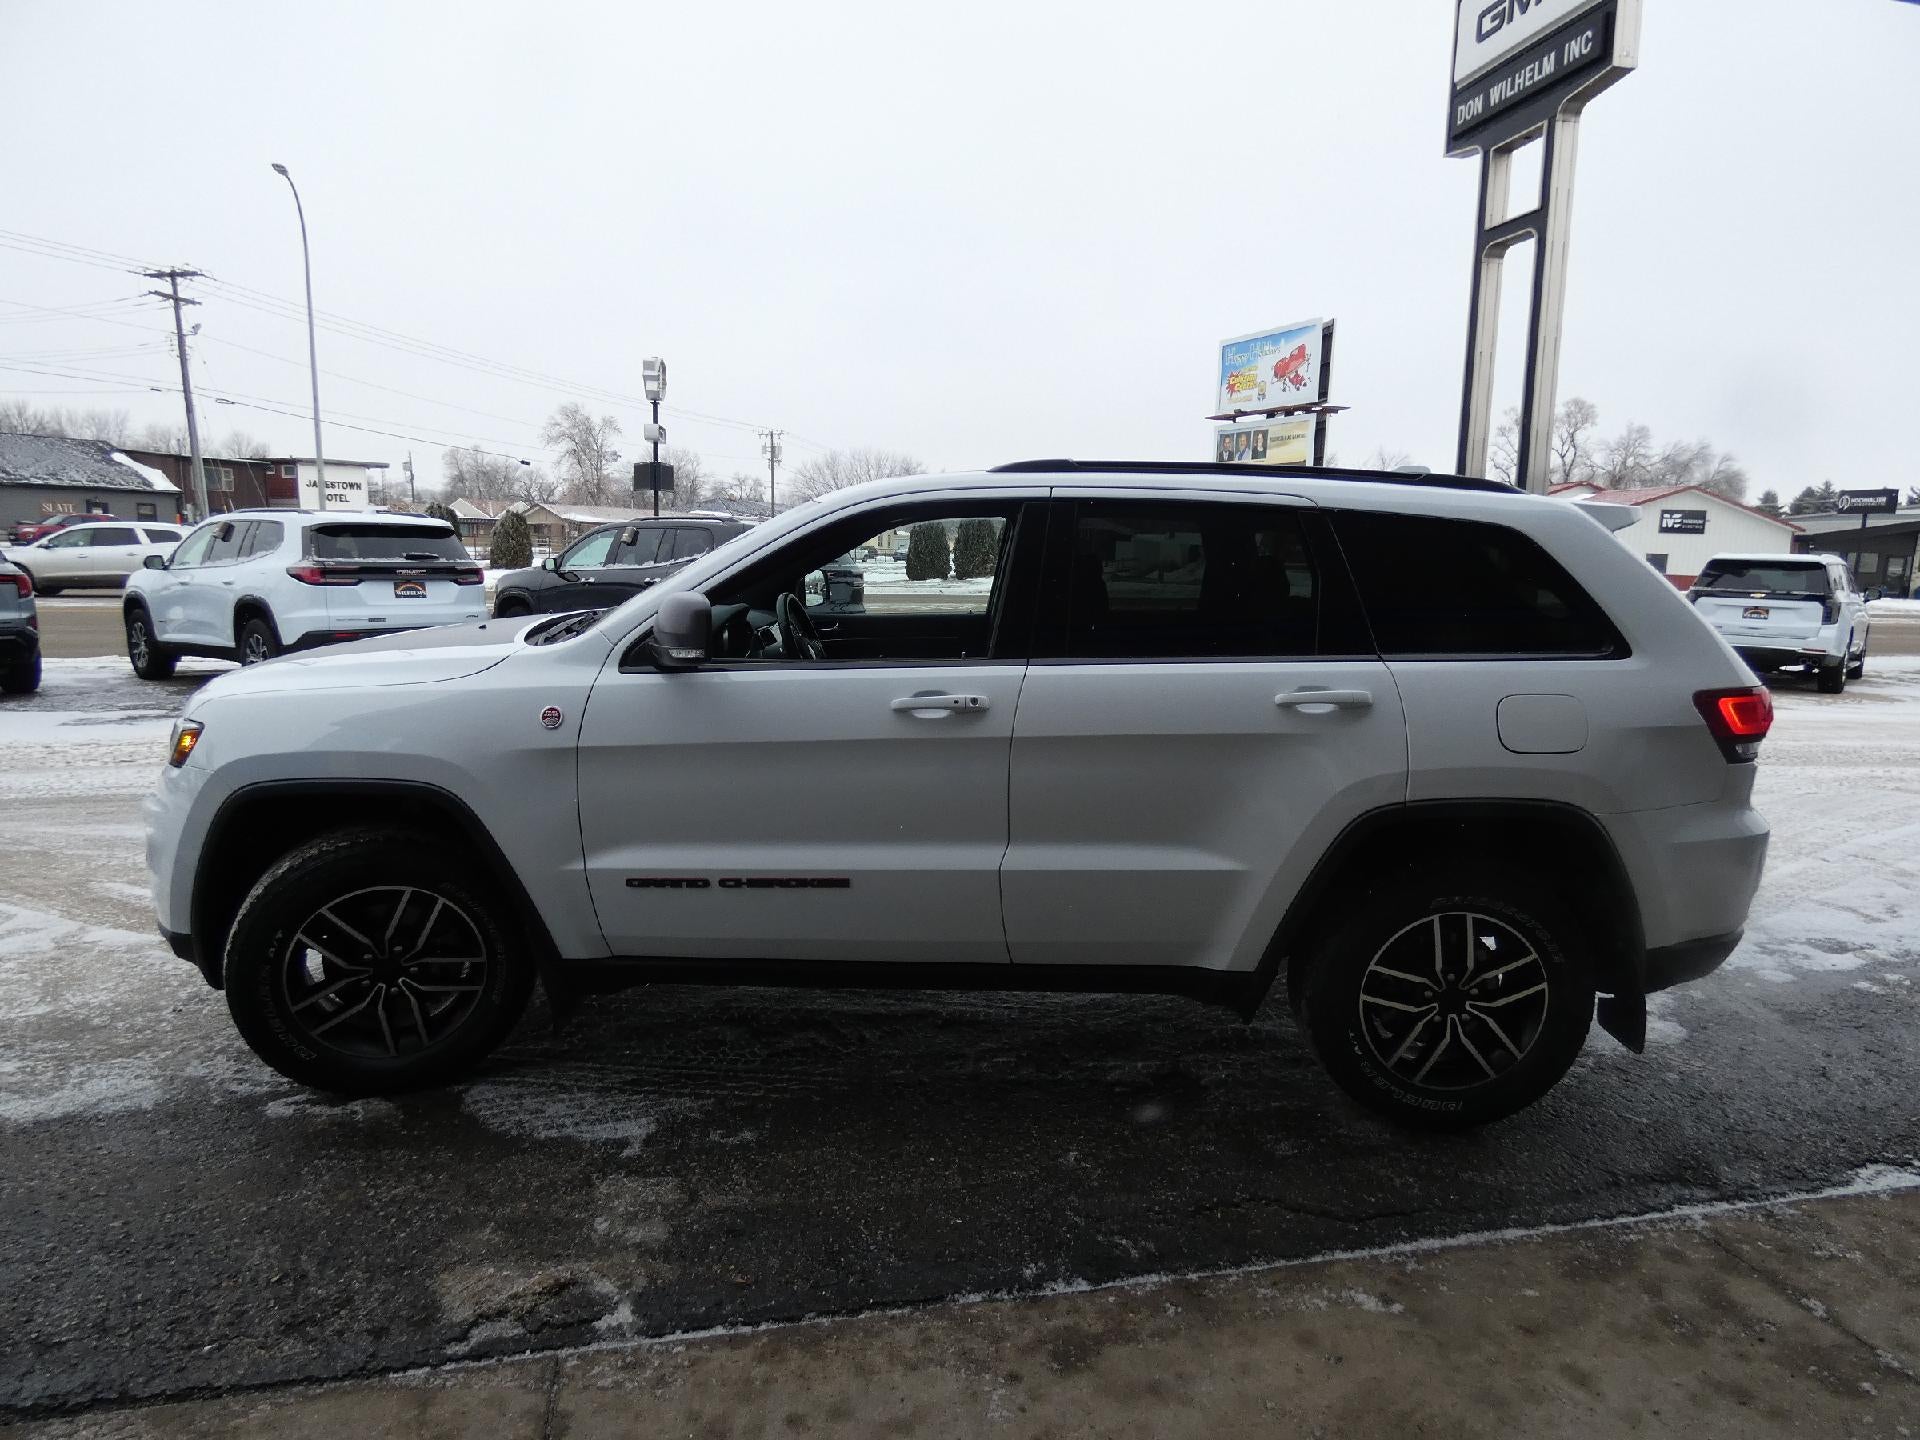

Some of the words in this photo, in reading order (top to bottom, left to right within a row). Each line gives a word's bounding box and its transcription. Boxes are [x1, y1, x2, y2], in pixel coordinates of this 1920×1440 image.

[1457, 94, 1483, 125] DON
[1489, 51, 1555, 107] WILHELM
[1563, 30, 1593, 66] INC
[306, 480, 362, 491] JAESTOWN
[324, 493, 350, 503] OTEL
